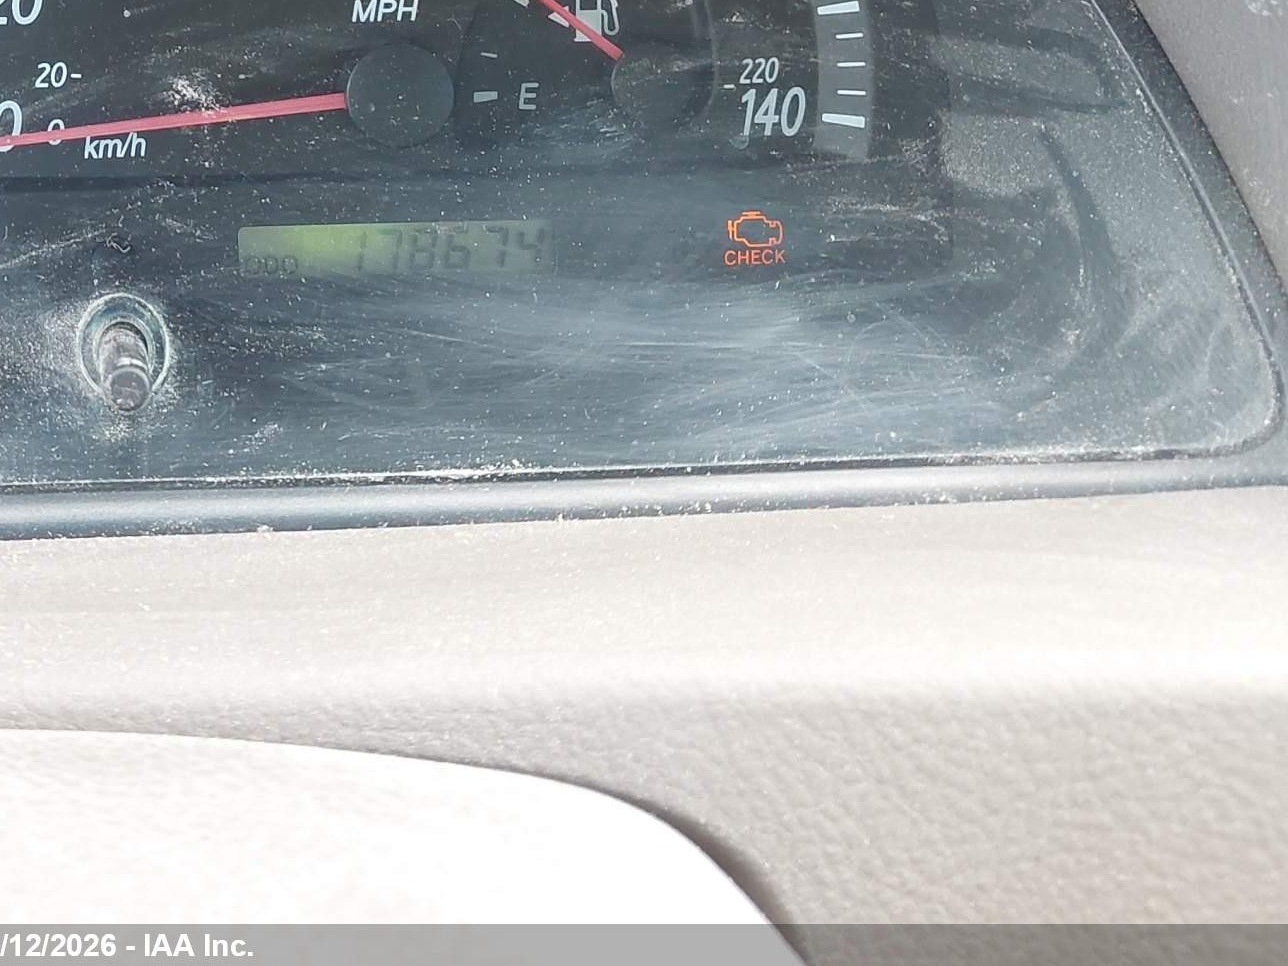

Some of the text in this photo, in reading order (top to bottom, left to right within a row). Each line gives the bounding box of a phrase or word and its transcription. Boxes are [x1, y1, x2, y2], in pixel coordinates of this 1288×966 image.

[351, 0, 419, 23] MPH
[34, 62, 68, 89] 20
[739, 57, 780, 84] 220
[519, 82, 540, 110] E
[739, 87, 806, 137] 140
[84, 131, 147, 160] km/h
[357, 227, 547, 272] 178674
[724, 249, 786, 266] CHECK
